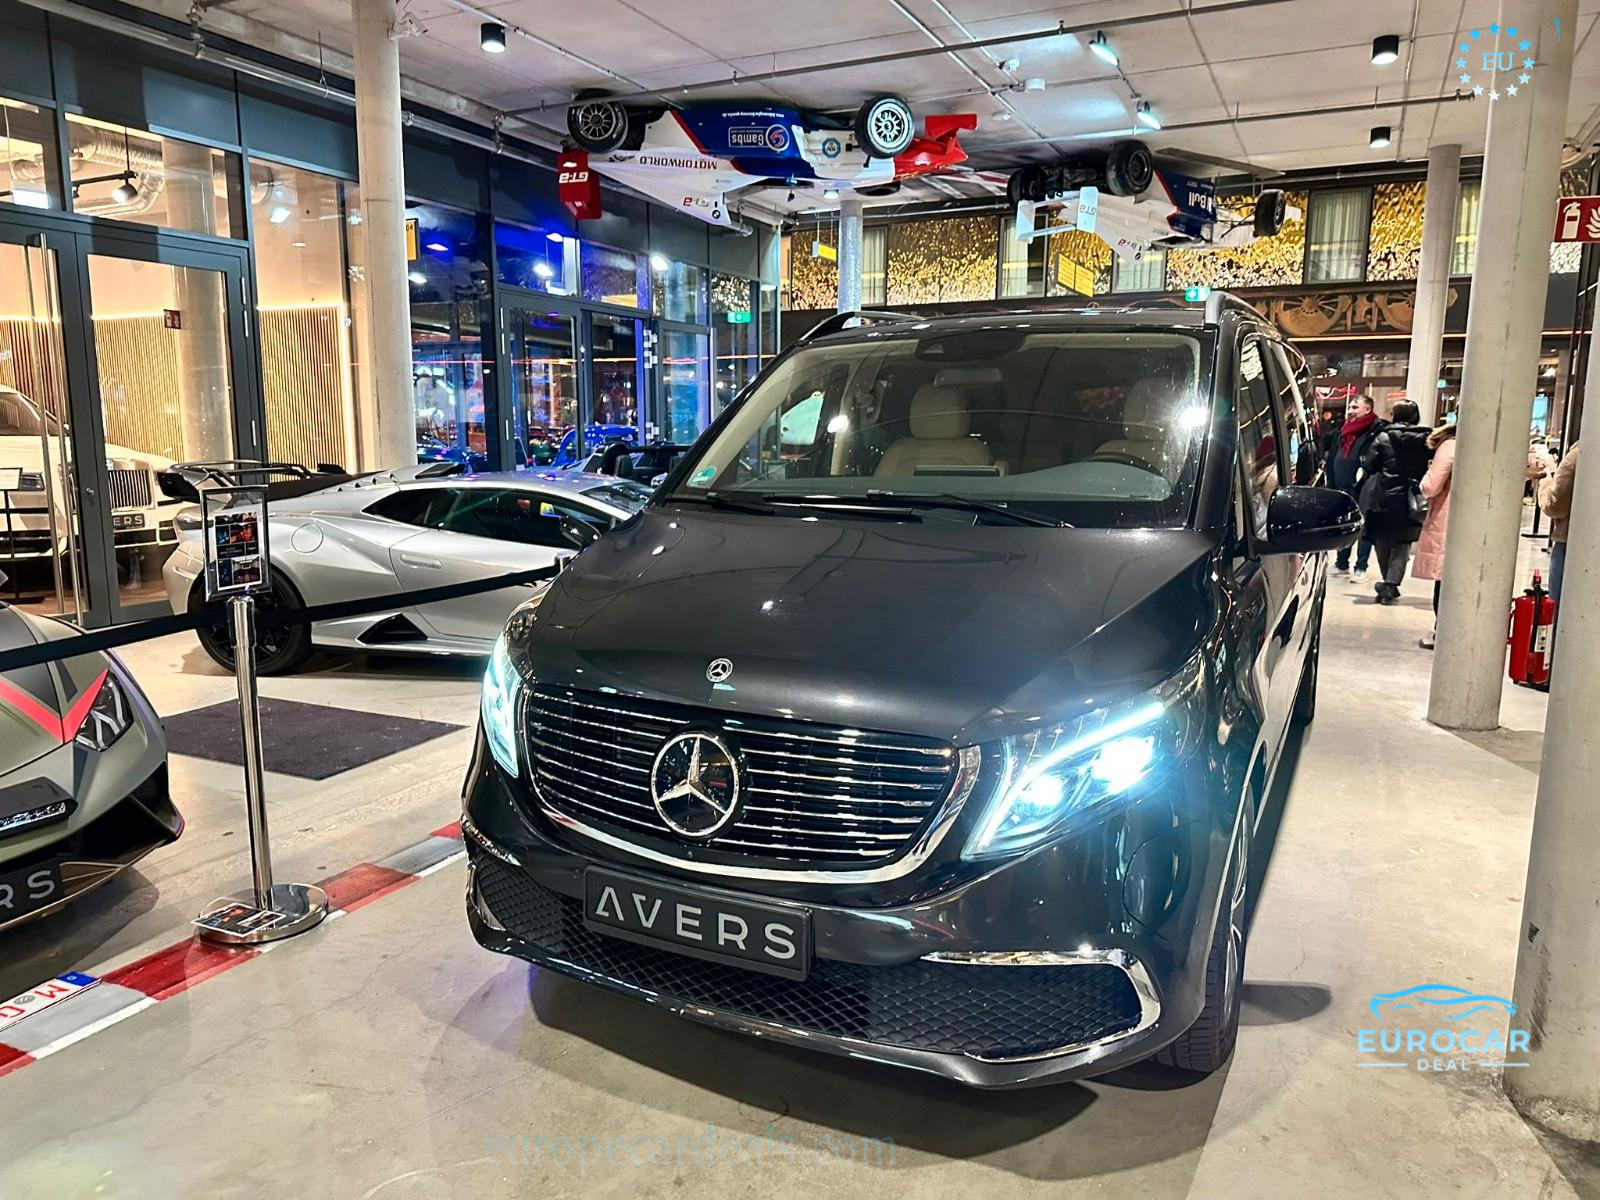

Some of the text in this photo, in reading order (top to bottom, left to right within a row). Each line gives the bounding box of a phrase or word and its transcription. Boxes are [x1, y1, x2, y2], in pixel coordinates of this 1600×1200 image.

[731, 134, 764, 146] Gambs
[640, 155, 718, 170] MOTORWORLD
[112, 515, 143, 527] ERS
[595, 886, 796, 960] AVERS
